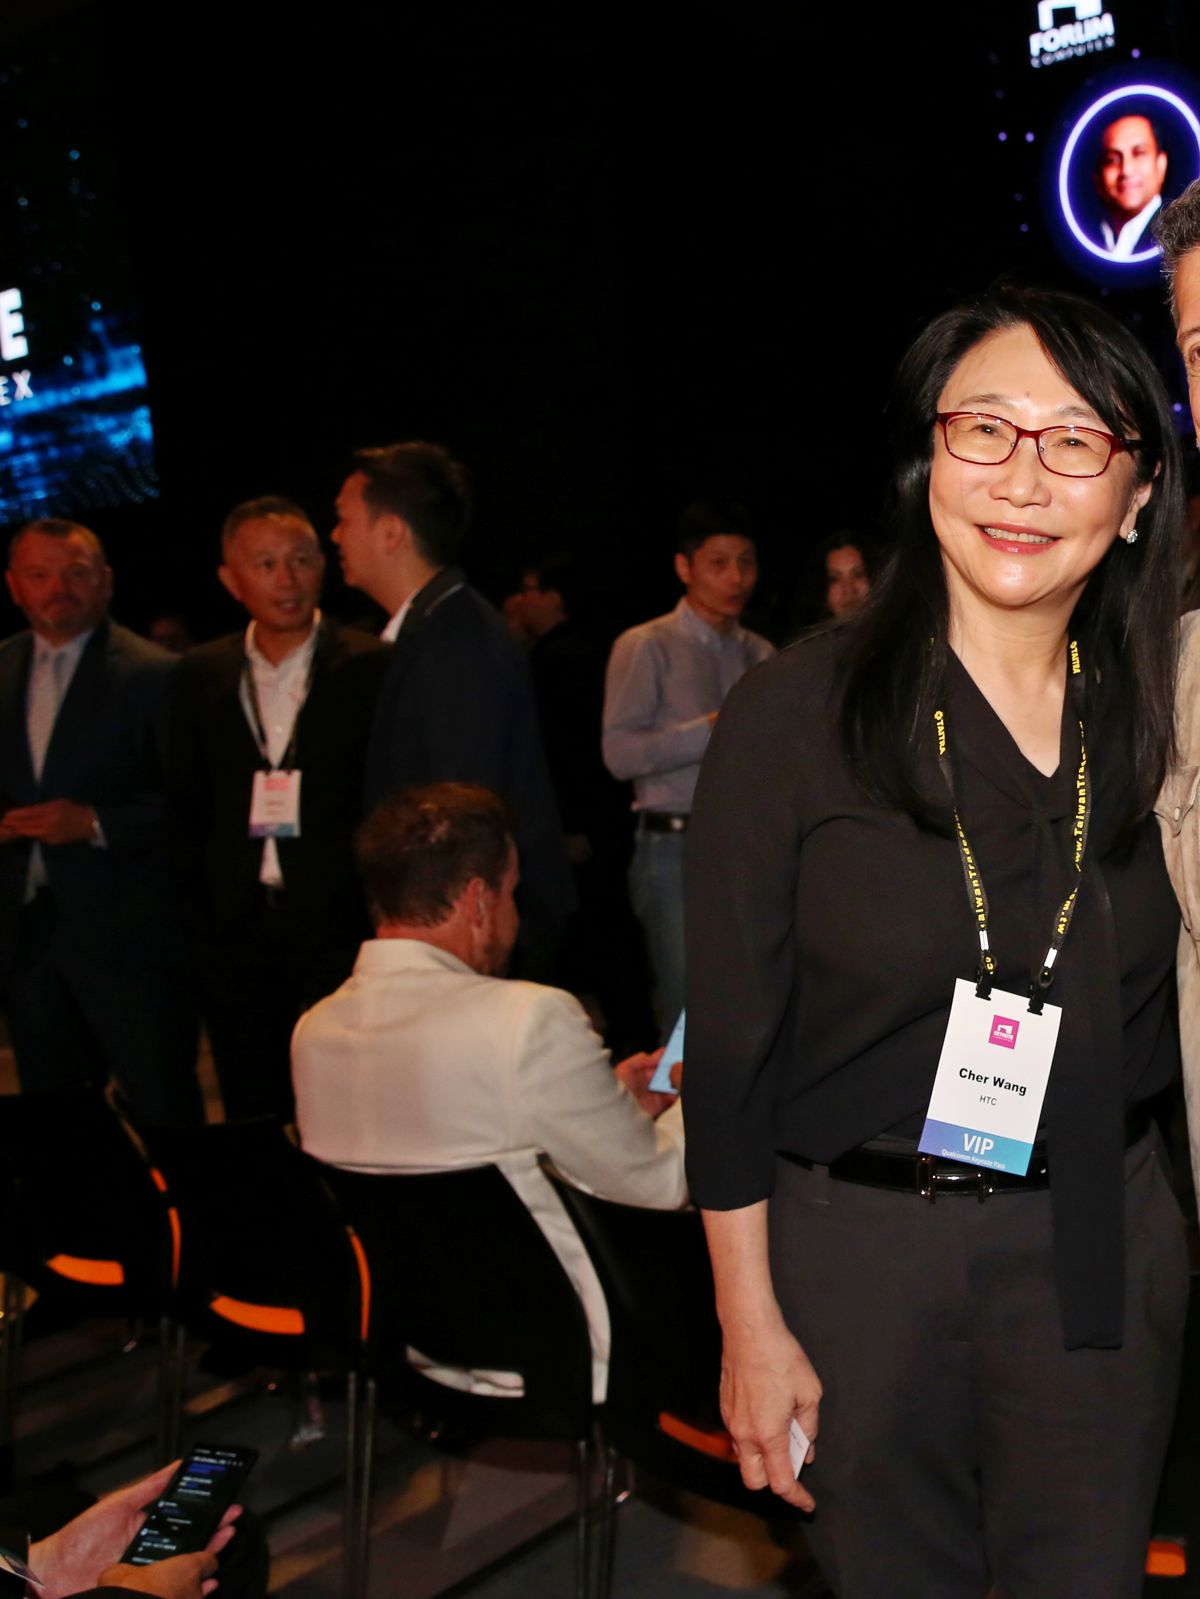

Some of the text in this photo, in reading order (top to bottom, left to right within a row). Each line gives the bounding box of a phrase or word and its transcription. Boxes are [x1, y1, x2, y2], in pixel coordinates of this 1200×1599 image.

[1029, 12, 1114, 56] FORUM
[959, 1068, 1028, 1097] Cher Wang
[979, 1094, 998, 1106] HTC
[963, 1132, 994, 1156] VIP
